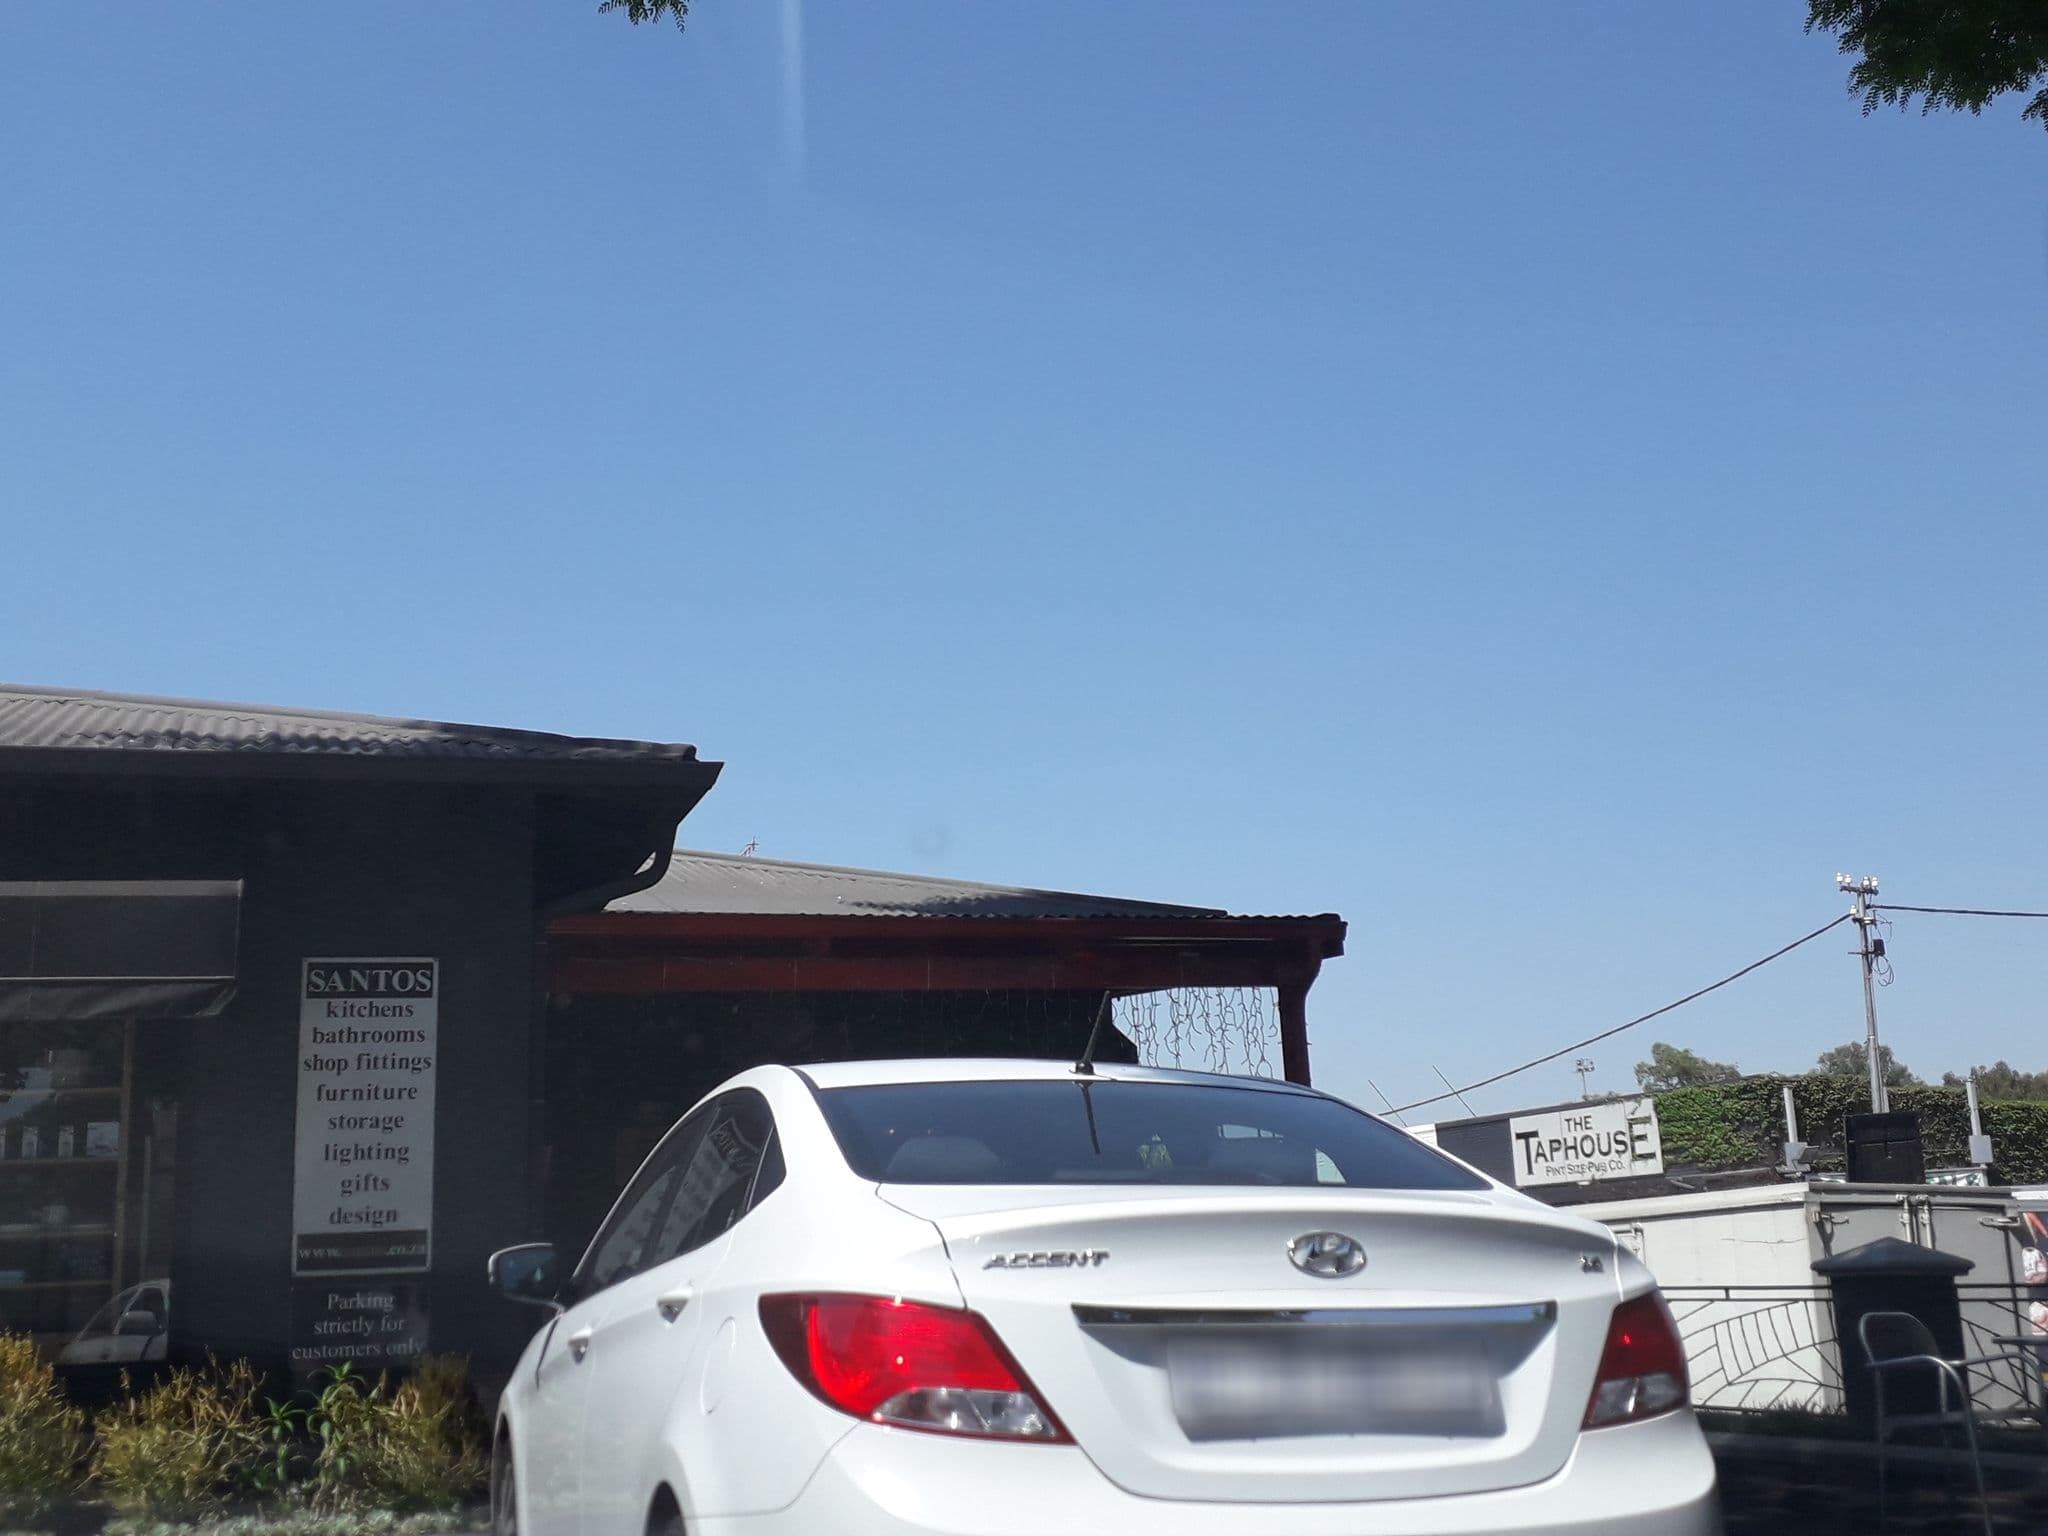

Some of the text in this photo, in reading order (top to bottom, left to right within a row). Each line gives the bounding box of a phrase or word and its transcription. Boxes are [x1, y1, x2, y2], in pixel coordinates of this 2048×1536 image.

[308, 969, 431, 992] SANTOS
[326, 1001, 414, 1018] kitchens
[312, 1027, 425, 1043] bathrooms
[303, 1053, 432, 1075] shop fittings
[316, 1083, 418, 1101] furniture
[328, 1113, 404, 1133] storage
[1565, 1115, 1593, 1133] THE
[324, 1142, 409, 1165] lighting
[1515, 1114, 1656, 1175] TAPHOUSE
[340, 1174, 390, 1197] gifts
[329, 1206, 398, 1227] design
[982, 1251, 1109, 1270] ACCENT
[327, 1293, 395, 1312] Parking
[314, 1314, 404, 1337] strictly for
[291, 1338, 425, 1360] customers only
